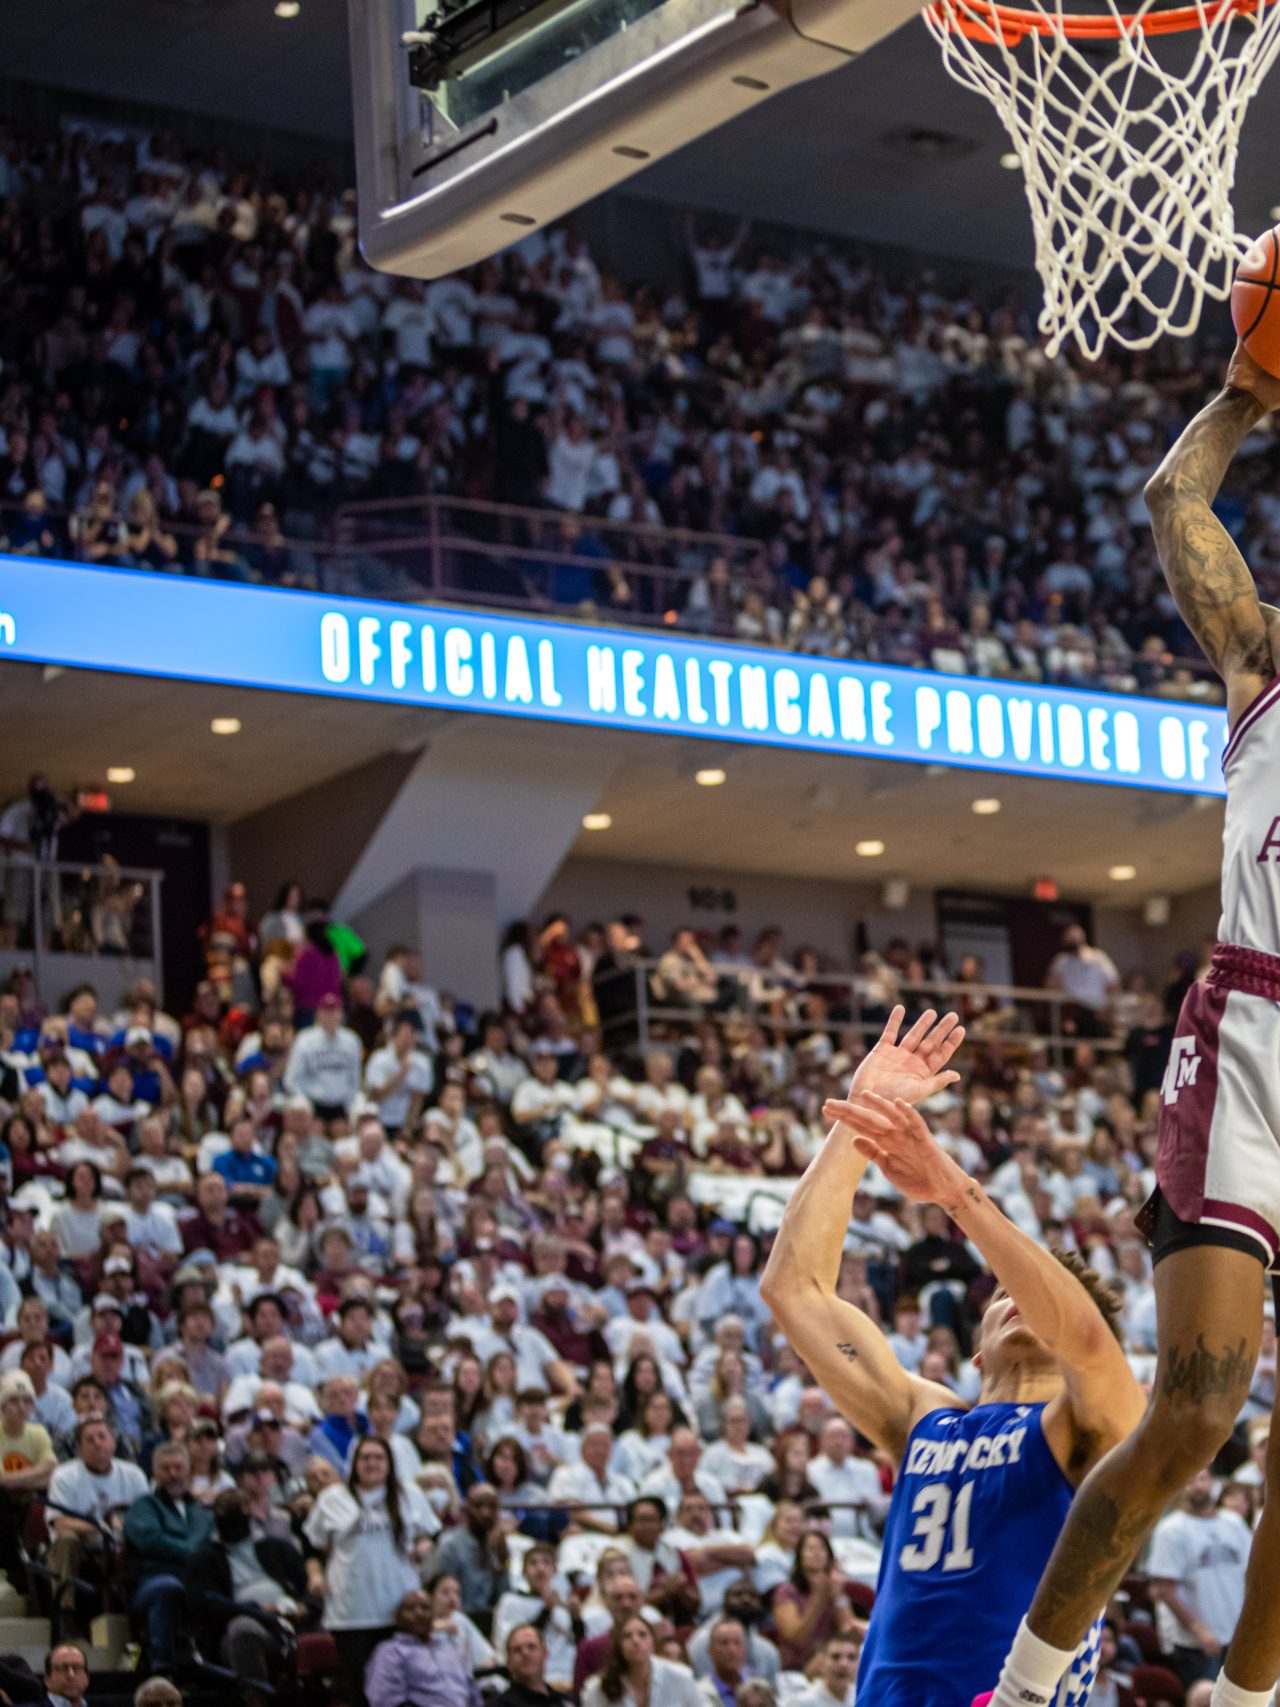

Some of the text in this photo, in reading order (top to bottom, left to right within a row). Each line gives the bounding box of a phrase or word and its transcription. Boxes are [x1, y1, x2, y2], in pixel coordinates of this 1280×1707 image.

[320, 611, 1210, 781] OFFICIAL HEALTHCARE PROVIDER OF
[899, 1480, 975, 1572] 31
